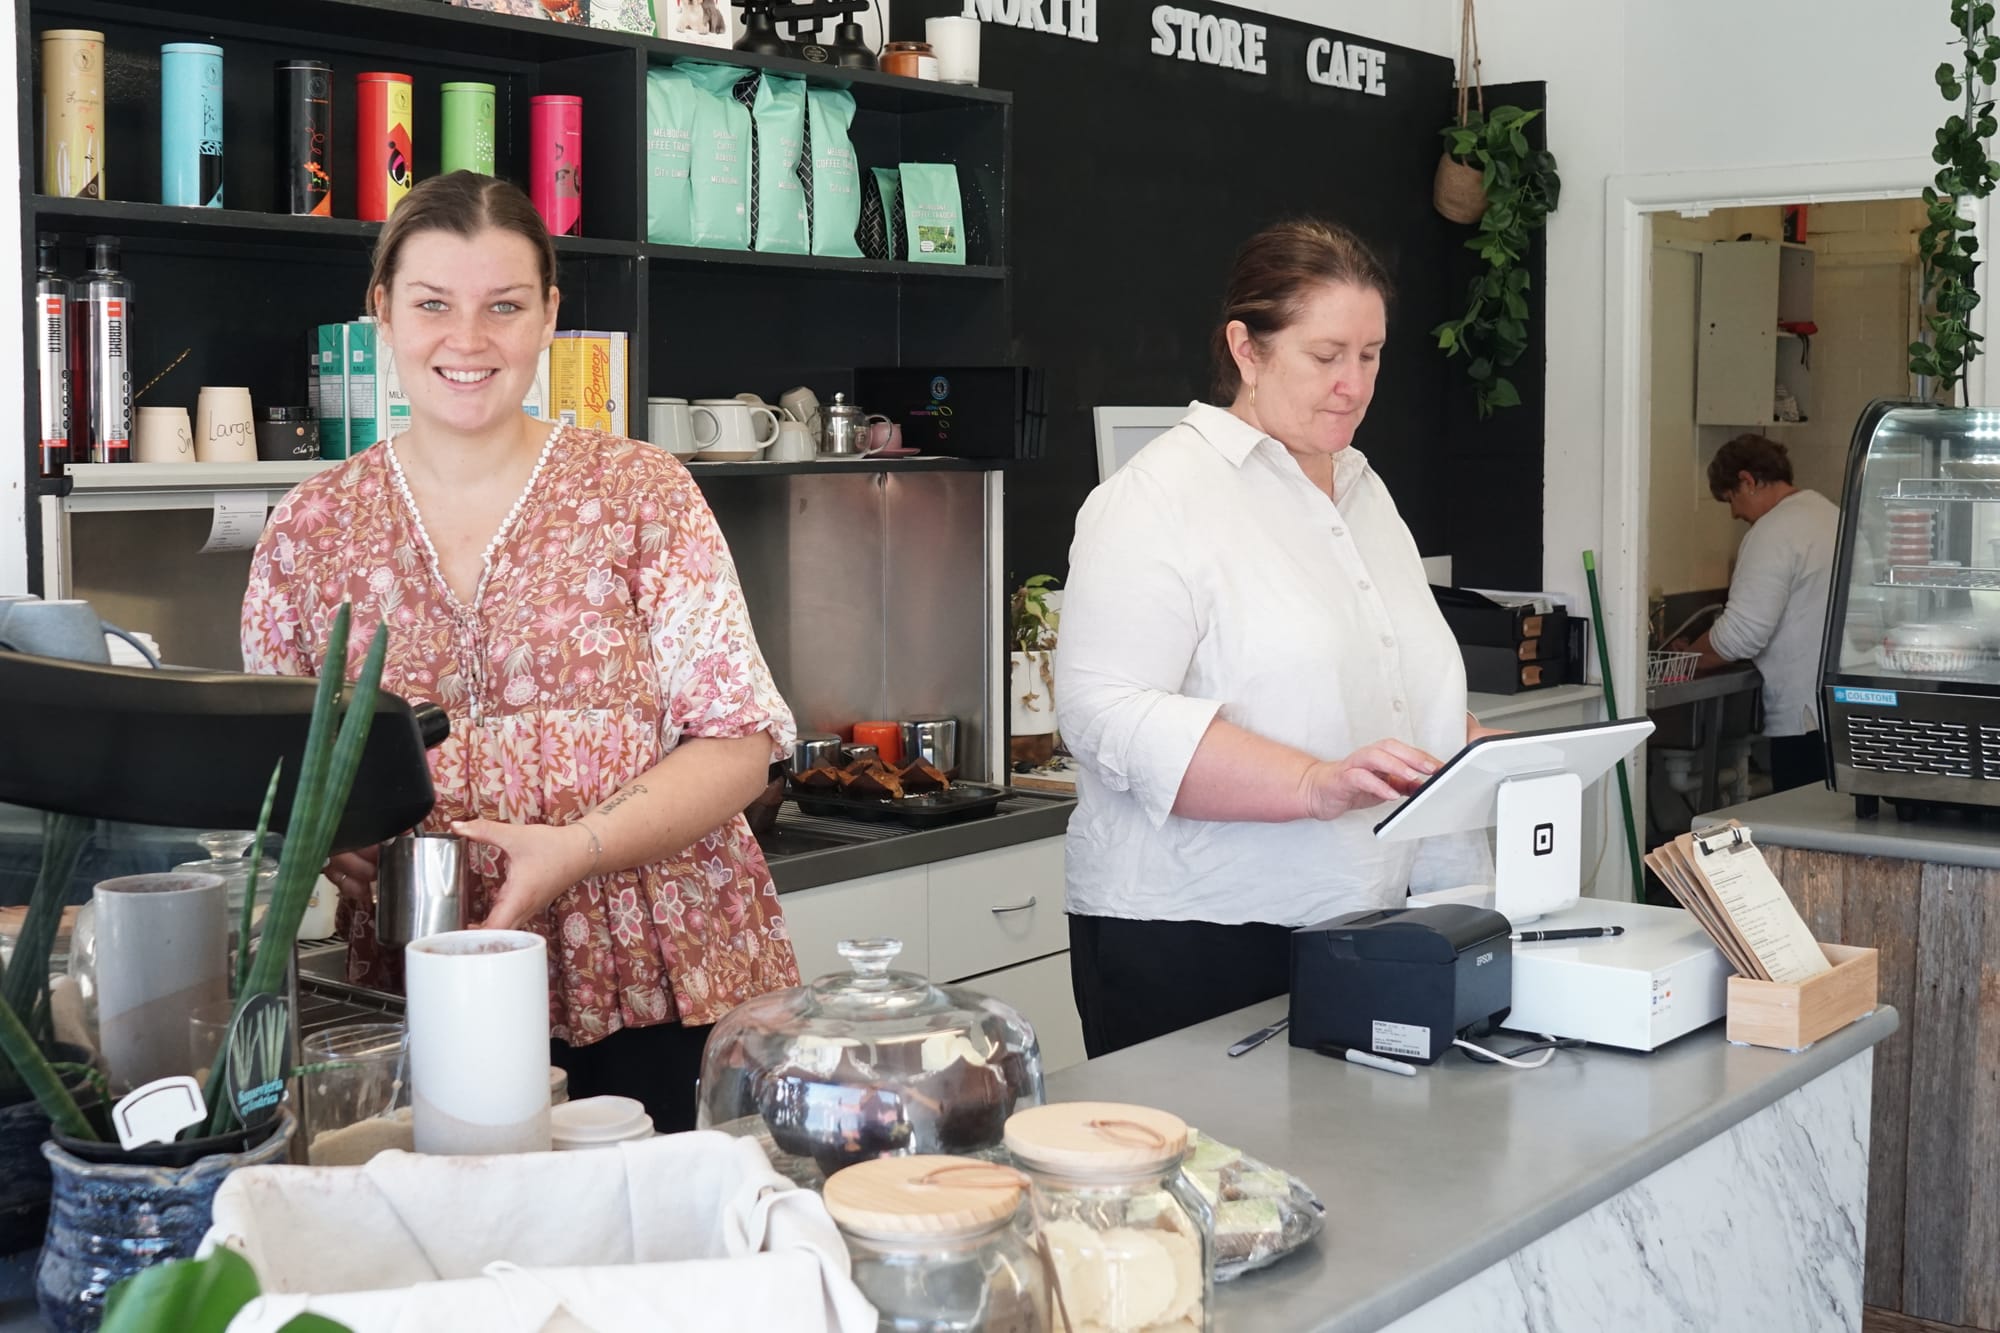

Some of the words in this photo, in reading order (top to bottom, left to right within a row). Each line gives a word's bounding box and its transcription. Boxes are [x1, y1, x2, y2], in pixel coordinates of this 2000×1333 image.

[1151, 5, 1266, 74] STORE
[1306, 37, 1386, 97] CAFE
[648, 141, 670, 151] OFFEE
[108, 320, 122, 359] CARAMEL
[209, 409, 254, 447] Large
[1847, 691, 1895, 703] COLSTONE
[1476, 951, 1493, 967] EPSON
